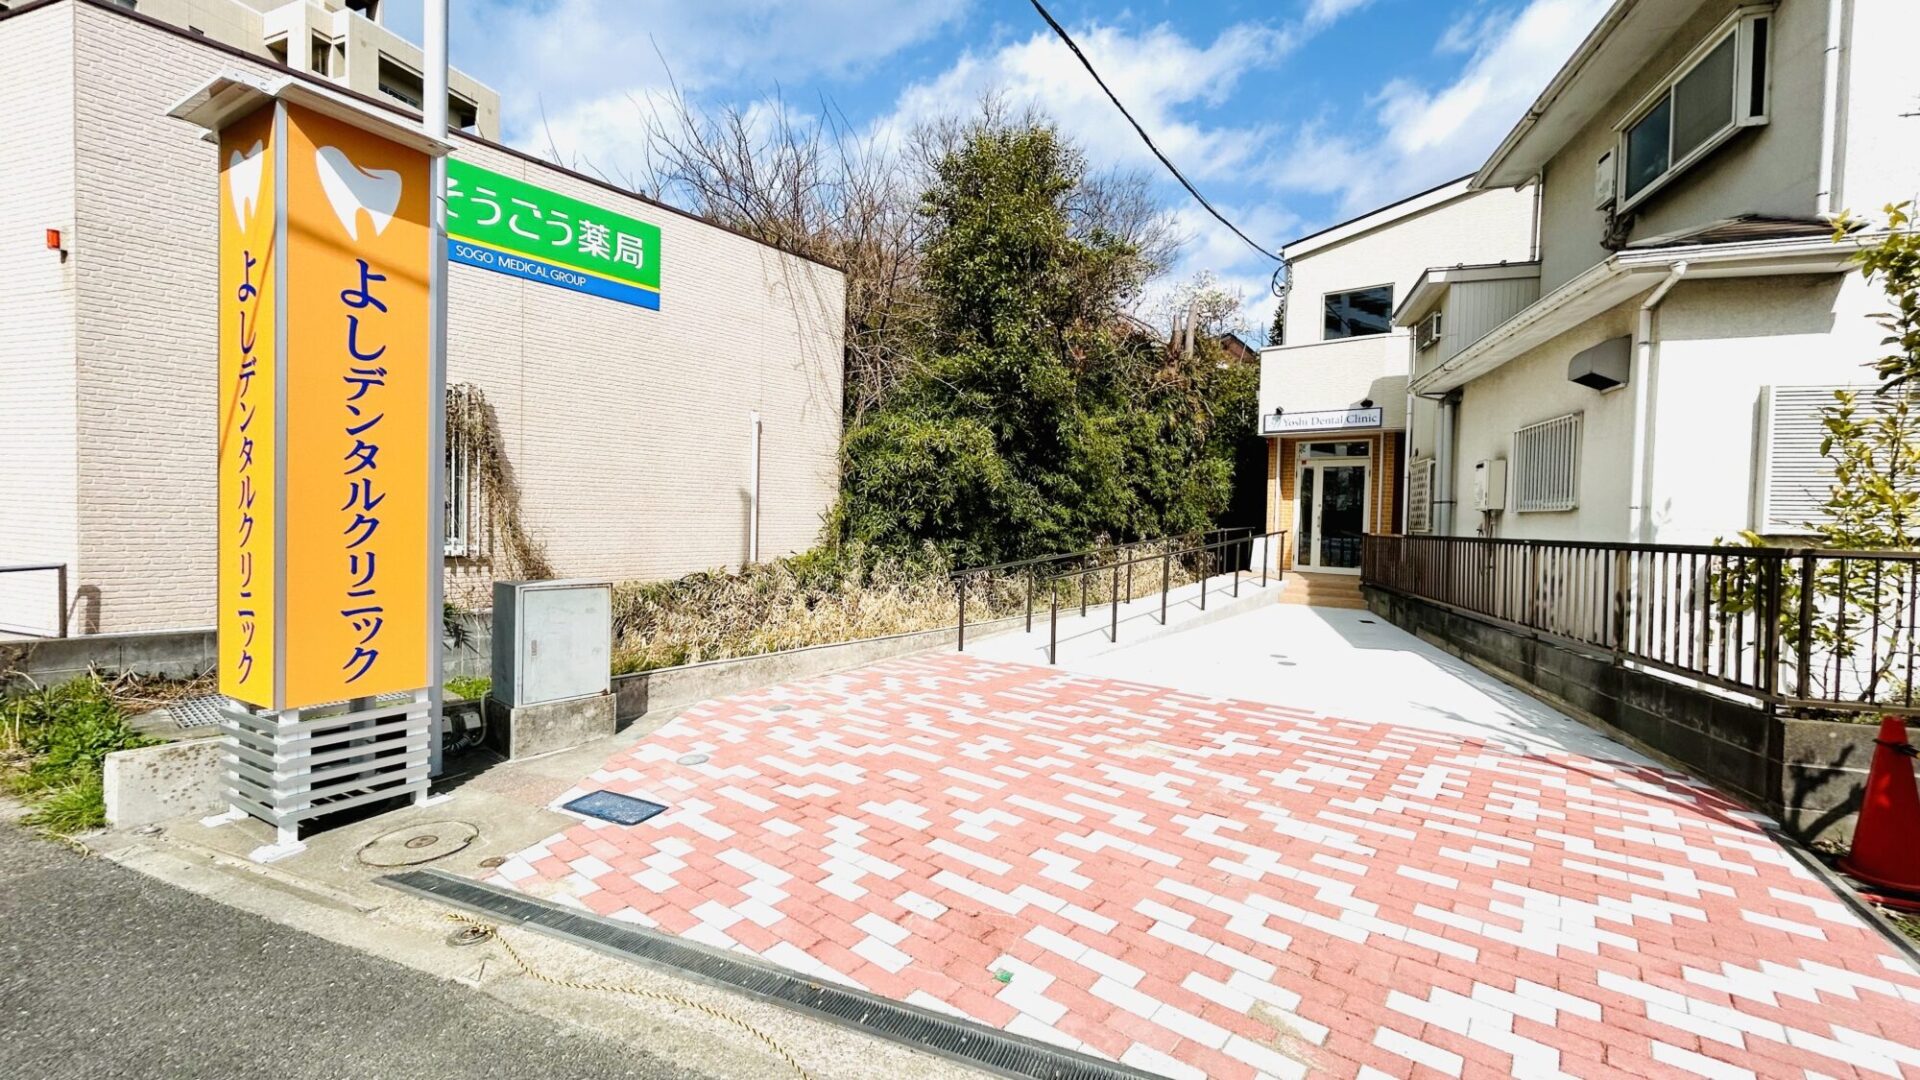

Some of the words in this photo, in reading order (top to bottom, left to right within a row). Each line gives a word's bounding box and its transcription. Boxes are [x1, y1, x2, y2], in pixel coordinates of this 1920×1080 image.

[455, 244, 494, 264] SOGO
[498, 255, 549, 278] MEDICAL
[550, 269, 587, 287] GROUP
[238, 250, 257, 685] よしデンタルクリニック
[340, 258, 388, 684] よしデンタルクリニック
[1283, 416, 1308, 427] Yoshi
[1311, 415, 1343, 426] Dental
[1346, 413, 1377, 424] Clinic
